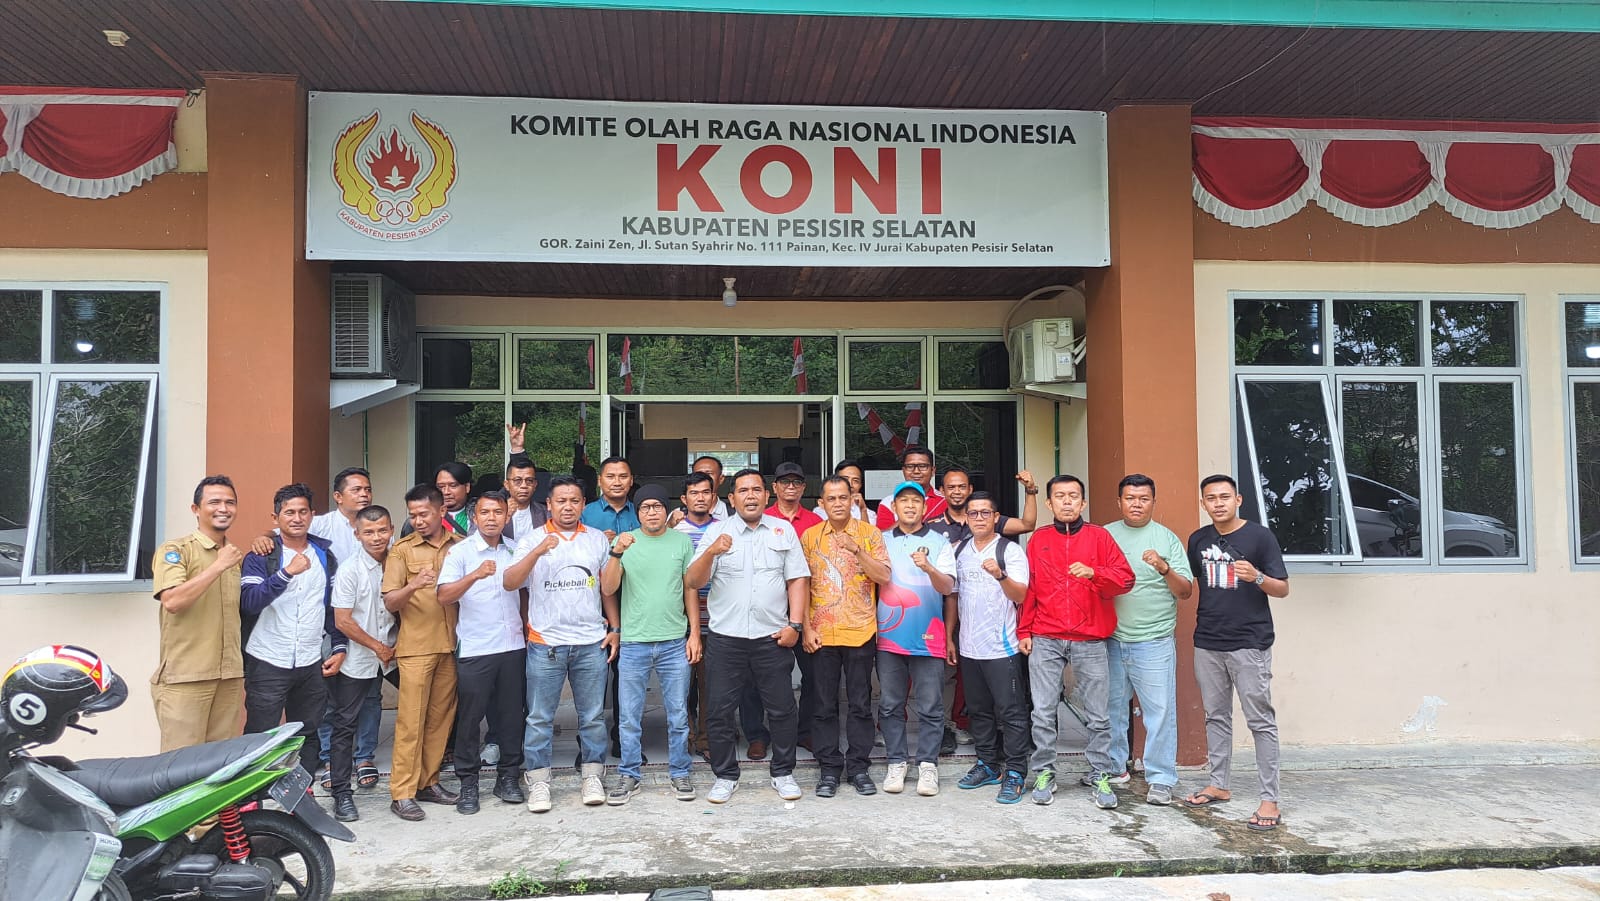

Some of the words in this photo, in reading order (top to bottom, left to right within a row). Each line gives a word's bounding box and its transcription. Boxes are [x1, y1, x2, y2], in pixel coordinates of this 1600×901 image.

[510, 115, 618, 137] KOMITE
[625, 118, 700, 140] OLAH
[708, 120, 783, 141] RAGA
[789, 121, 926, 143] NASIONAL
[931, 123, 1077, 145] INDONESIA
[657, 143, 942, 215] KONI
[339, 210, 384, 239] KABUPATEN
[385, 231, 417, 240] PESISIR
[417, 213, 450, 236] SELATAN
[622, 217, 769, 237] KABUPATEN
[777, 219, 865, 238] PESISIR
[872, 220, 976, 239] SELATAN
[540, 238, 572, 249] GOR.
[576, 239, 605, 249] Zaini
[608, 240, 635, 251] Zen,
[637, 240, 652, 250] Jl.
[655, 240, 689, 250] Sutan
[691, 240, 734, 253] Syahrir
[736, 241, 757, 252] No.
[760, 242, 782, 252] 111
[787, 242, 829, 253] Painan,
[832, 242, 857, 252] Kec.
[860, 243, 872, 252] IV
[874, 243, 902, 253] Jurai
[905, 242, 969, 255] Kabupaten
[971, 243, 1009, 253] Pesisir
[1011, 243, 1054, 253] Selatan
[544, 579, 587, 589] Pickleball
[15, 698, 41, 721] 5
